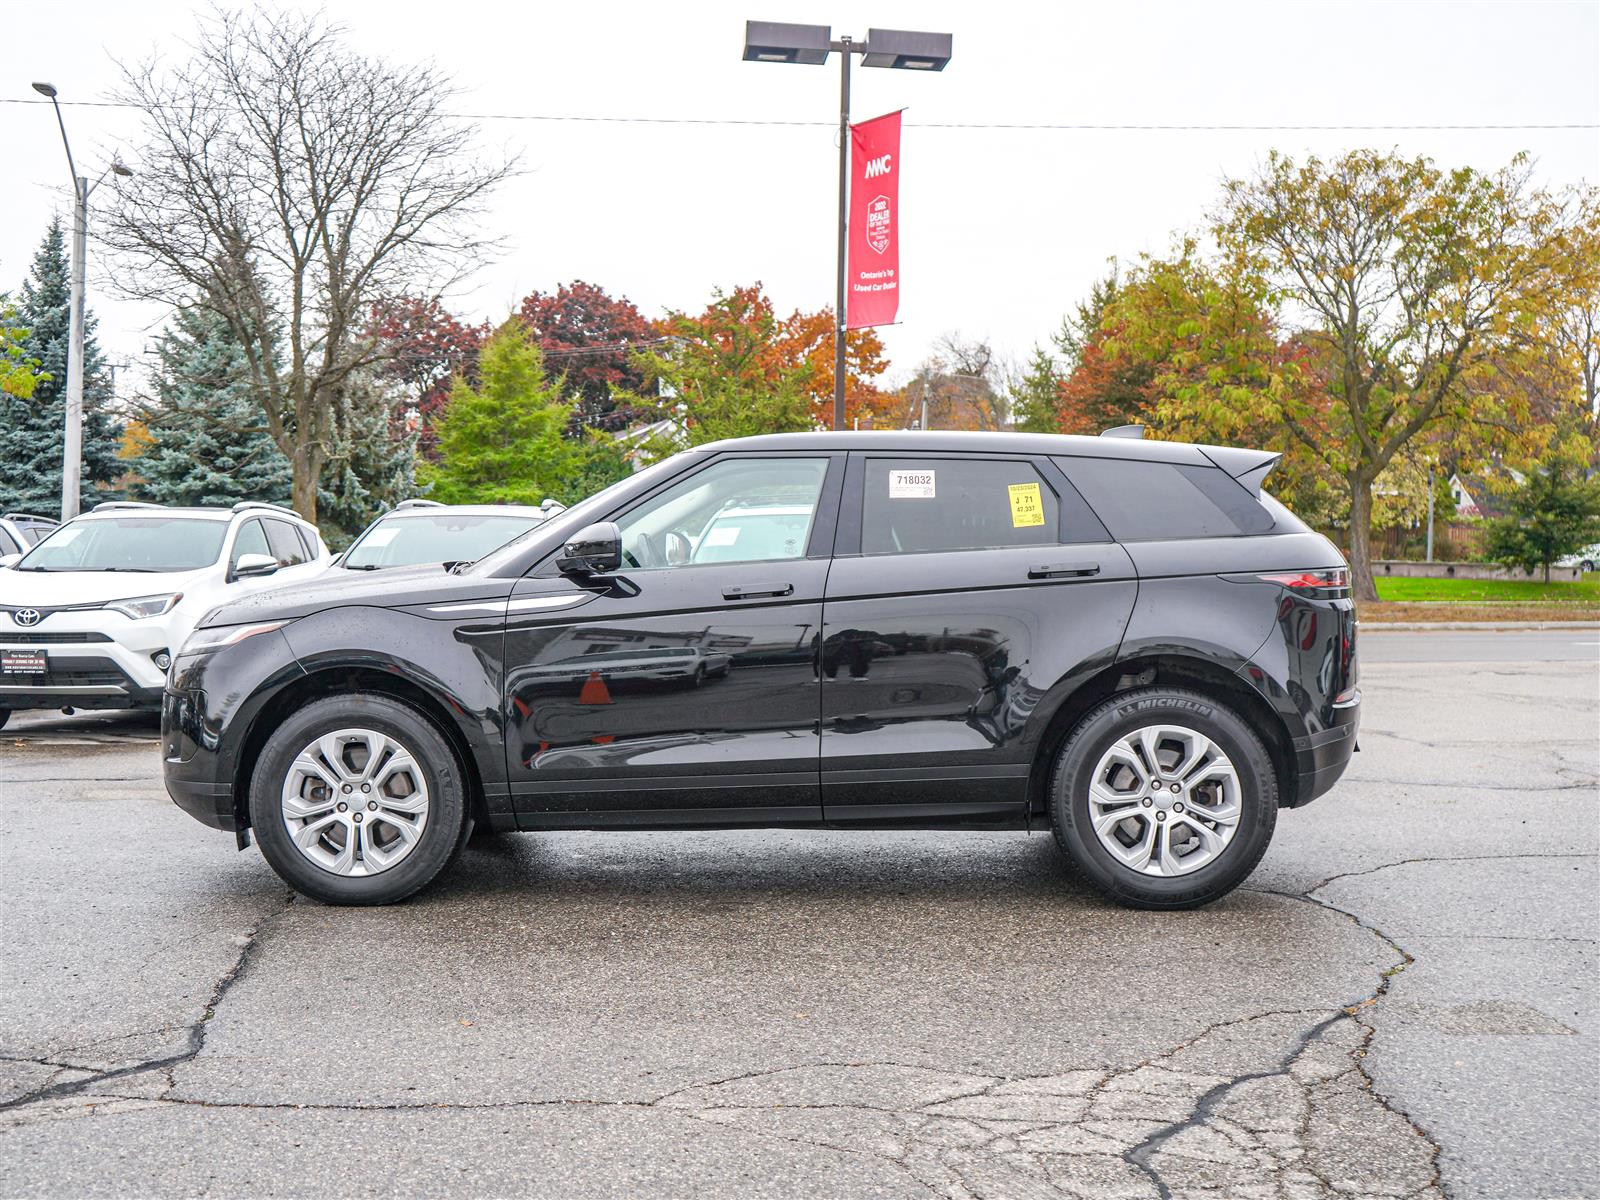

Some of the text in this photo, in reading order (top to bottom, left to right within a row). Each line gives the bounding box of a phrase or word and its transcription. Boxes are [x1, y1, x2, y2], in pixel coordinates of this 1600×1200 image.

[870, 209, 890, 222] DEALER
[860, 270, 887, 279] Ontario's
[854, 283, 872, 292] Used
[897, 475, 932, 485] 718032
[1137, 698, 1212, 716] MICHELIN
